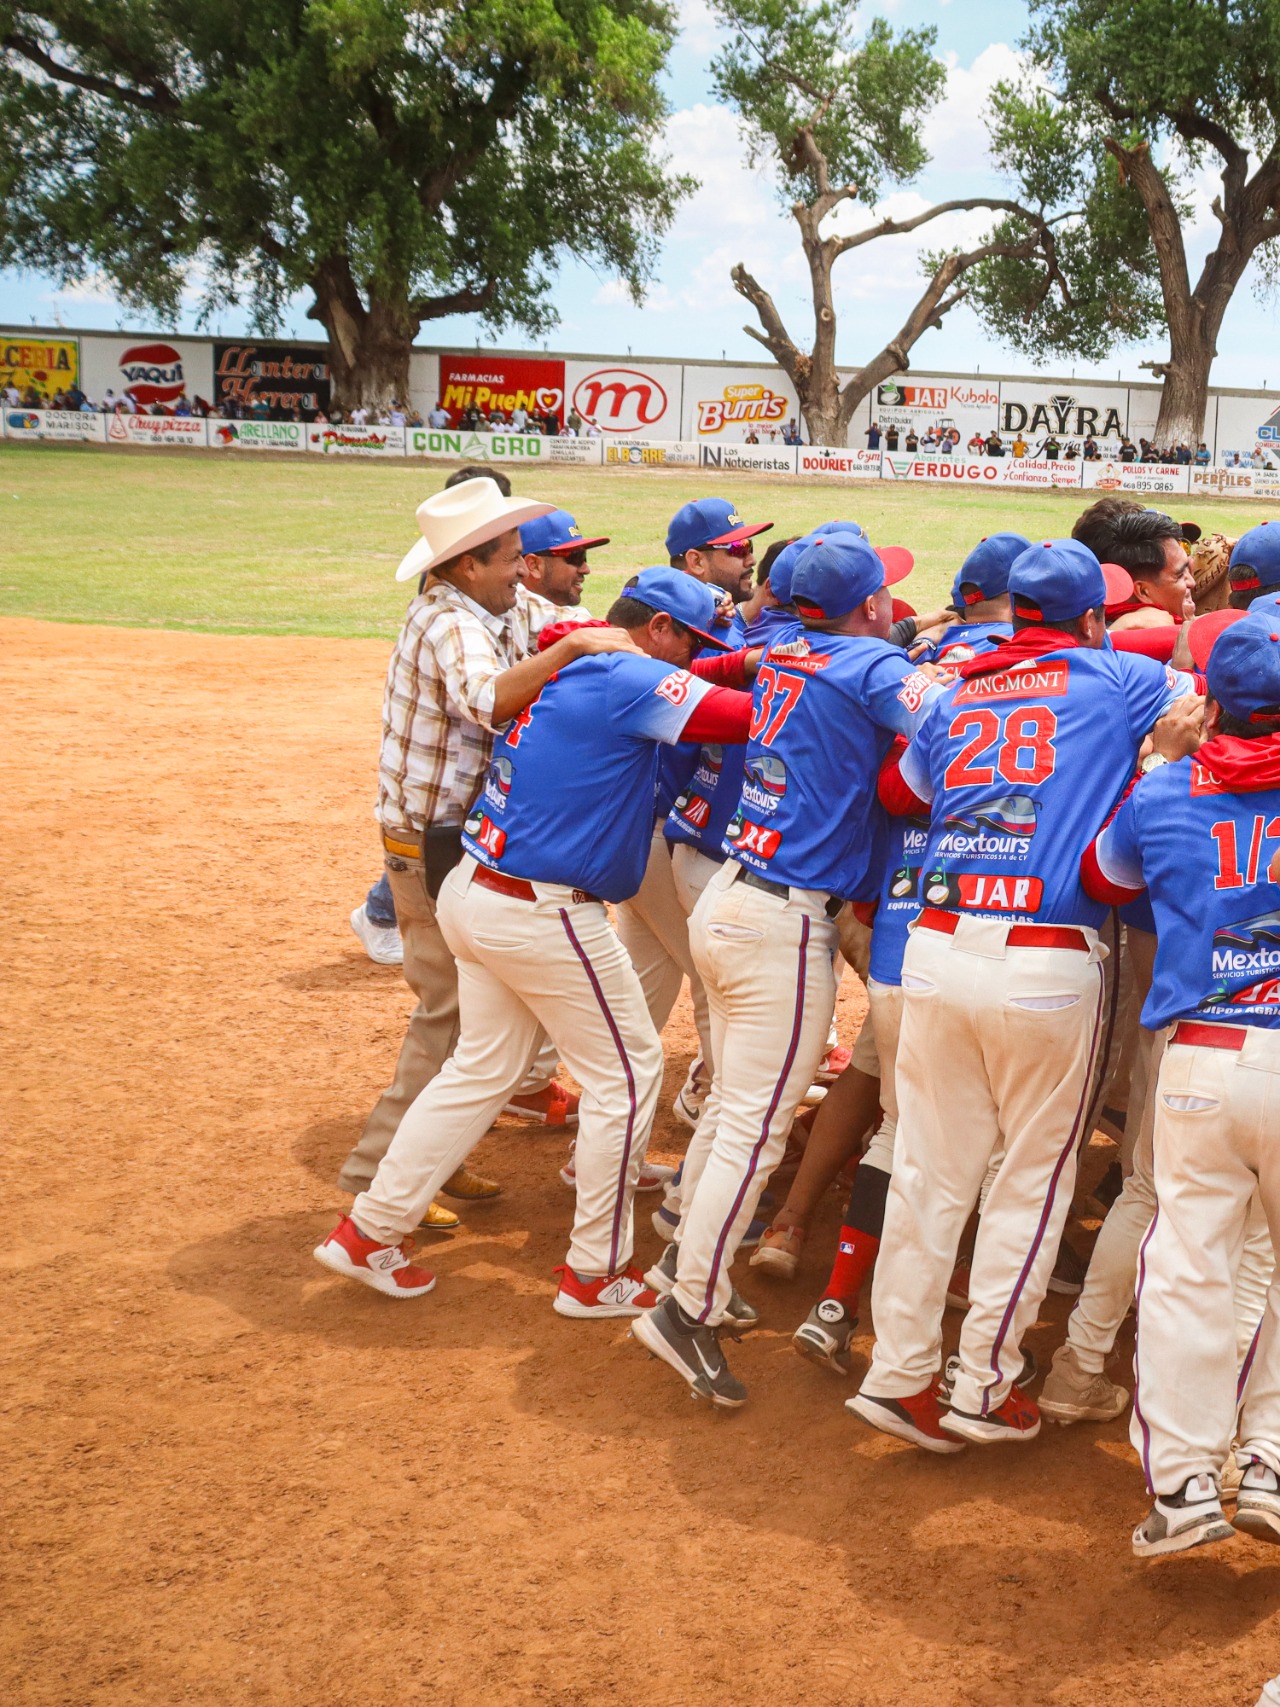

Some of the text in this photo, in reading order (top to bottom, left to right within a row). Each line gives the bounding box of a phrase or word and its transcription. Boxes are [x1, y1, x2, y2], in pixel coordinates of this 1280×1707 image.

[449, 372, 505, 384] FARMACIAS
[443, 384, 472, 409] Mi
[727, 384, 760, 398] Super
[909, 388, 946, 408] JAR
[951, 386, 998, 405] Kubota
[46, 411, 97, 421] DOCTORA
[1002, 402, 1125, 441] DAYRA
[46, 421, 96, 431] MARISOL
[240, 423, 299, 439] ARELLANO
[607, 447, 620, 462] EL
[724, 447, 738, 456] Los
[857, 450, 880, 464] Gym
[914, 453, 967, 464] Abarrotes
[724, 457, 790, 471] Noticieristas
[803, 457, 852, 472] DOURIET
[1051, 461, 1075, 472] Precio
[1123, 465, 1180, 476] POLLOS Y CARNE
[1136, 481, 1152, 490] 895
[1154, 482, 1174, 491] 0865
[1194, 473, 1252, 488] PERFILES
[749, 664, 805, 748] 37
[944, 705, 1058, 791] 28
[937, 833, 1031, 855] Mextours
[966, 877, 1030, 908] JAR
[1212, 971, 1245, 980] SERVICIOS
